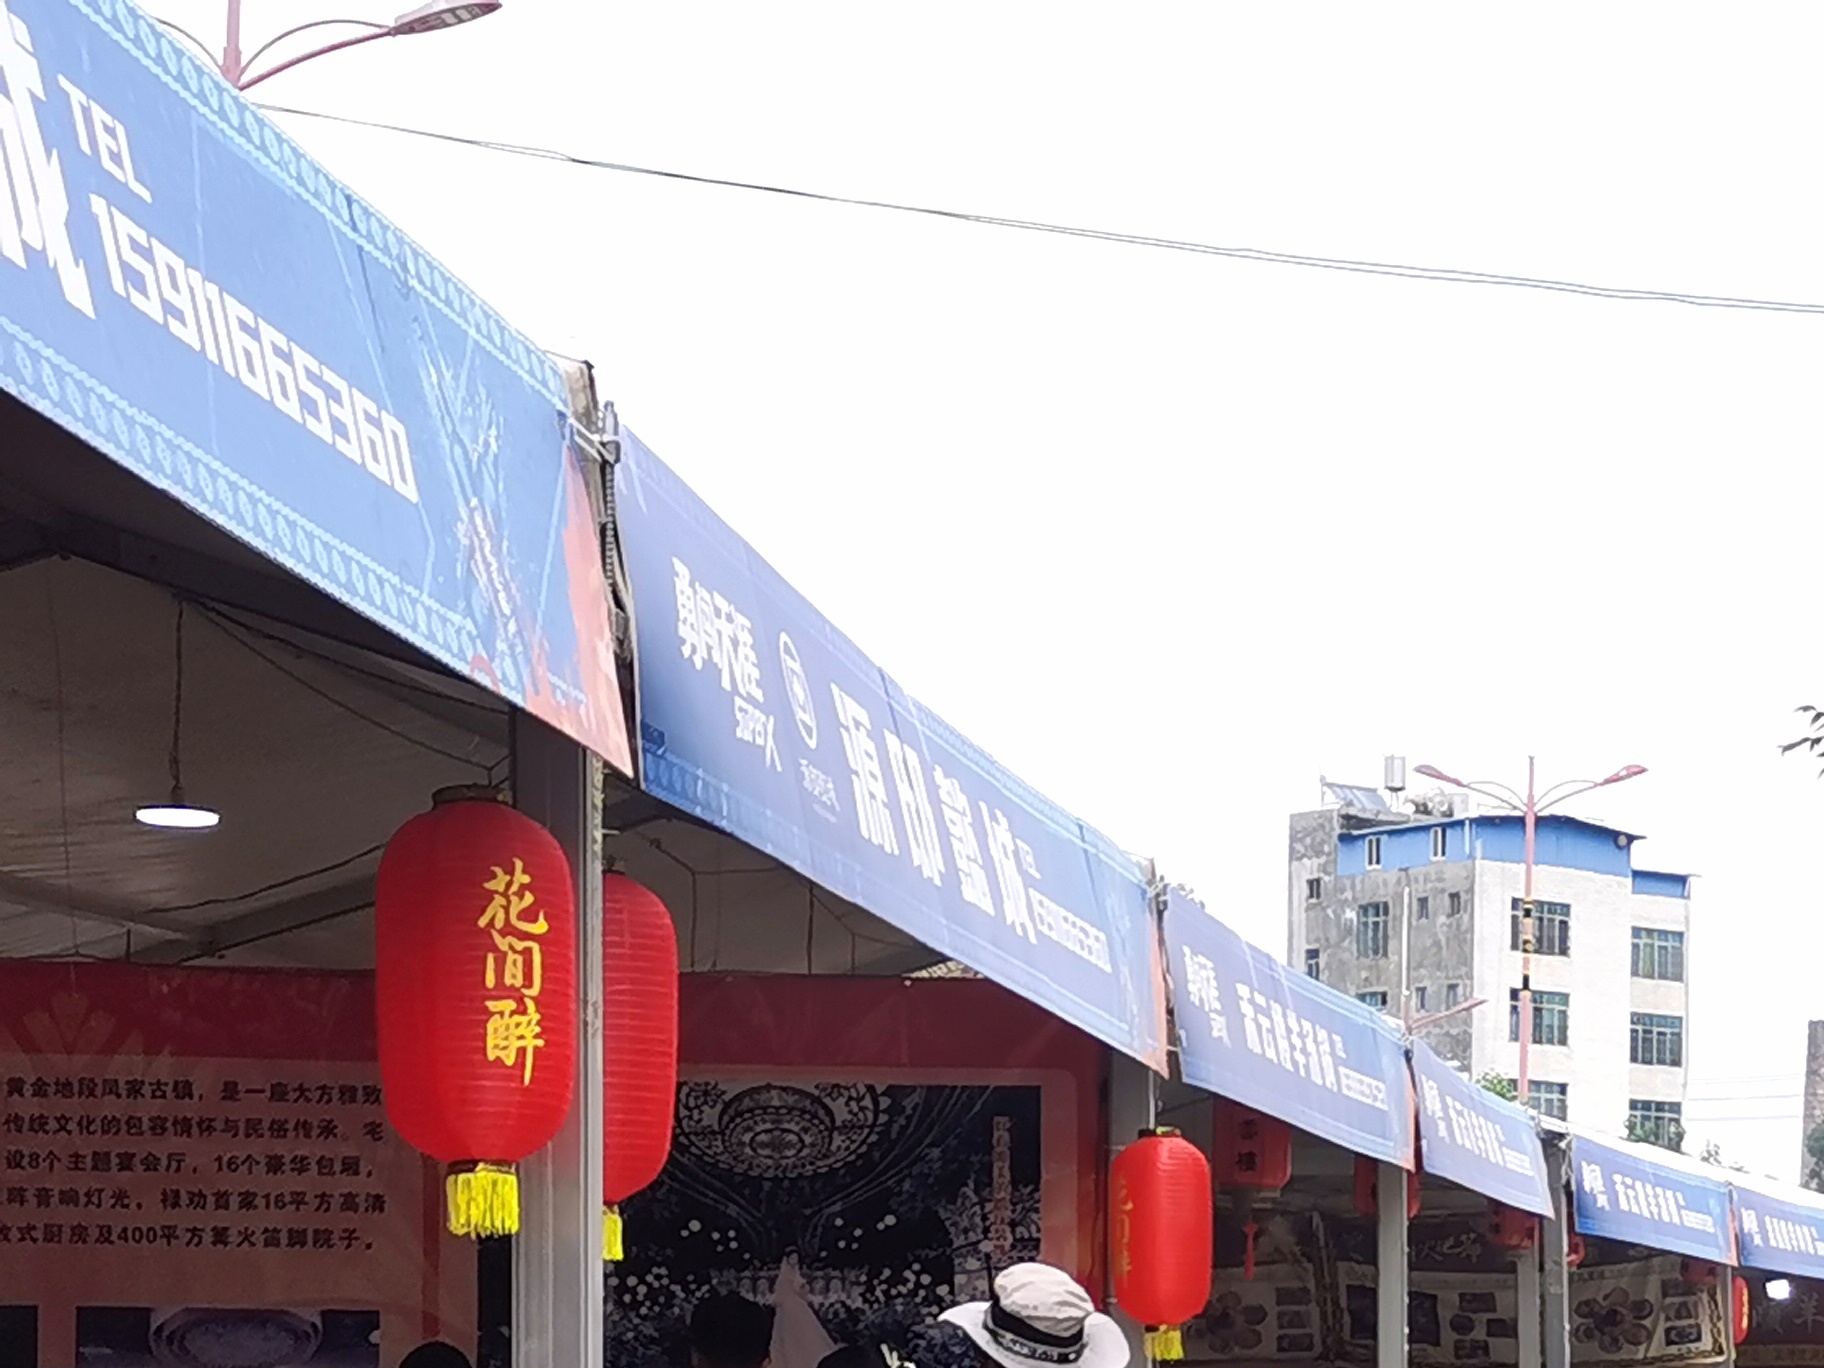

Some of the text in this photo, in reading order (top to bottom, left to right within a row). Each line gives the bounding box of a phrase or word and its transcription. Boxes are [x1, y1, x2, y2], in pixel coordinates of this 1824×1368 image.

[57, 73, 152, 204] TEL
[88, 192, 420, 503] 15911665360
[477, 857, 549, 1087] 花间醉
